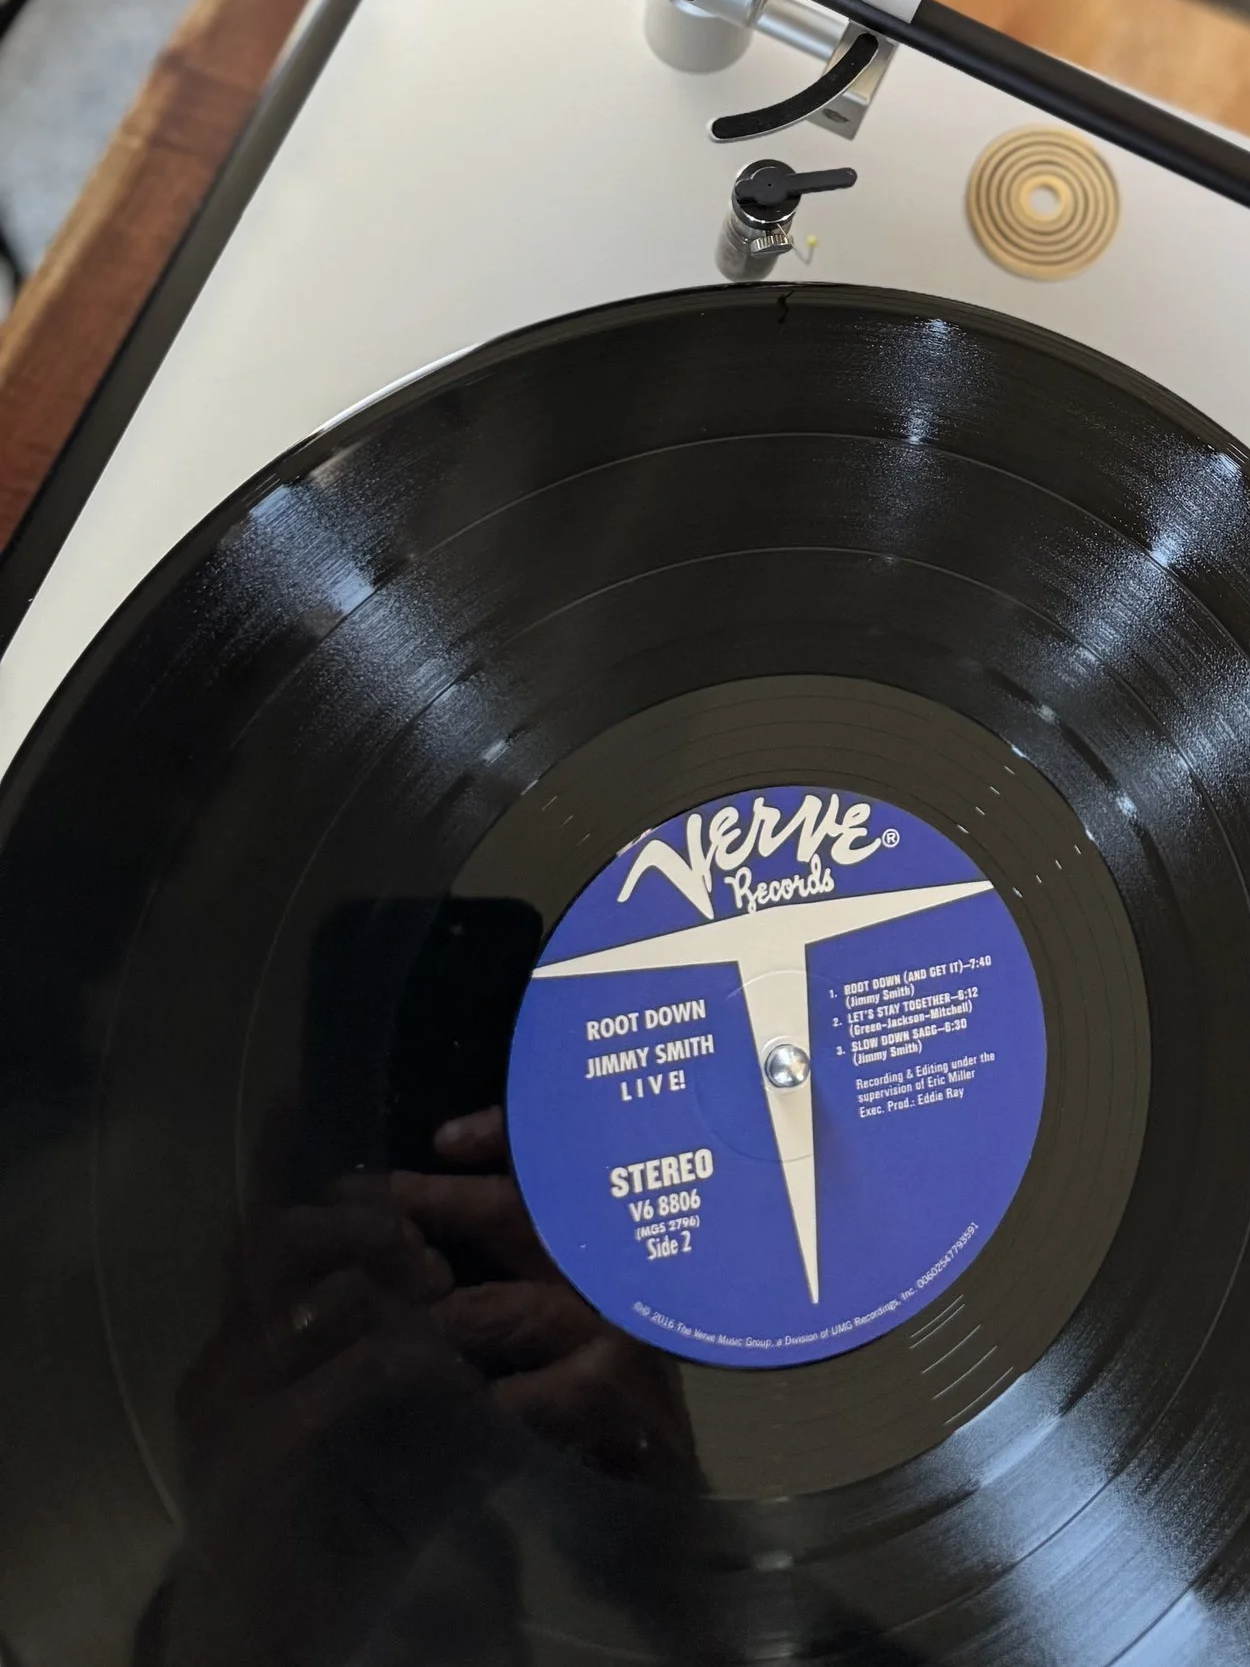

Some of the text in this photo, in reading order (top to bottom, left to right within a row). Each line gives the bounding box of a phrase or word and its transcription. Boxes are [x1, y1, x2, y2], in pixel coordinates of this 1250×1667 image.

[724, 854, 835, 912] Records
[829, 989, 838, 998] 1.
[844, 981, 870, 995] ROOT
[872, 974, 901, 990] DOWN
[903, 970, 927, 984] (AND
[929, 964, 947, 977] GET
[846, 984, 915, 1010] (Jimmy Smith)
[586, 999, 706, 1041] ROOT DOWN
[832, 1017, 842, 1027] 2.
[848, 1008, 875, 1023] LET'S
[877, 1003, 900, 1018] STAY
[585, 1033, 715, 1079] JIMMY SMITH
[836, 1046, 846, 1056] 3.
[851, 1038, 879, 1052] SLOW
[881, 1031, 910, 1046] DOWN
[853, 1040, 923, 1067] (Jimmy Smith)
[856, 1051, 995, 1090] Recording & Editing under the
[858, 1069, 976, 1103] supervision of Eric Miller
[860, 1087, 965, 1118] Exec. Prod.: Eddie Ray
[610, 1148, 714, 1198] STEREO
[629, 1188, 701, 1223] V6 8806
[635, 1214, 700, 1241] (MGS 2796)
[647, 1230, 692, 1260] Side 2
[651, 1311, 675, 1329] 2016
[676, 1322, 692, 1336] The
[694, 1327, 716, 1342] Verve
[717, 1334, 742, 1347] Music
[776, 1339, 783, 1347] a
[784, 1332, 819, 1346] Division
[820, 1328, 830, 1339] of
[831, 1321, 853, 1335] UMG
[853, 1298, 902, 1327] Recordings,
